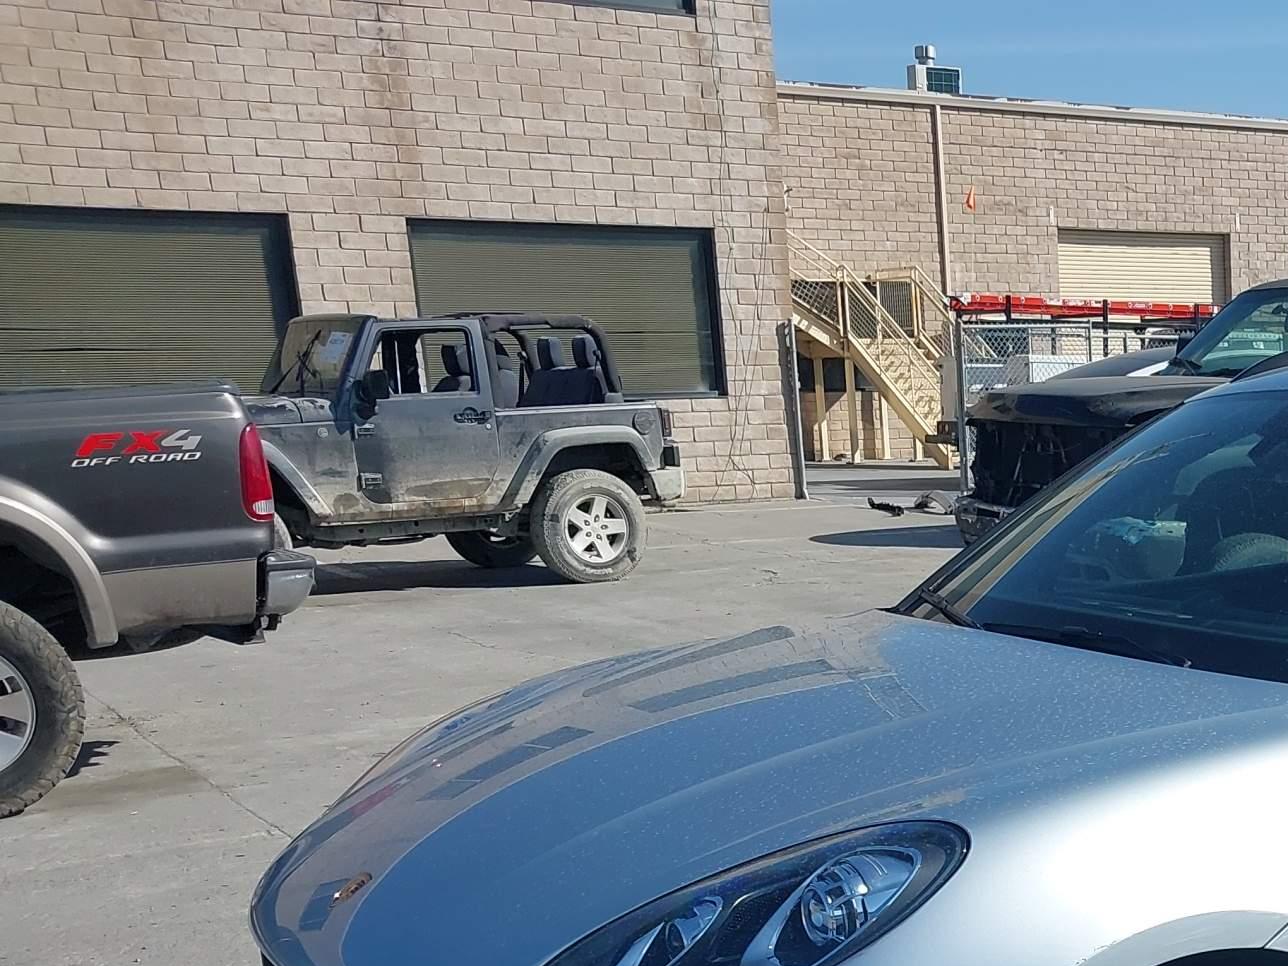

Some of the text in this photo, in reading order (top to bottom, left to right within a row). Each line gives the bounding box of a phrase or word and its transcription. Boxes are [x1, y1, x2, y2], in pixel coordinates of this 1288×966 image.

[76, 429, 202, 457] FX4
[71, 452, 202, 468] OFF ROAD
